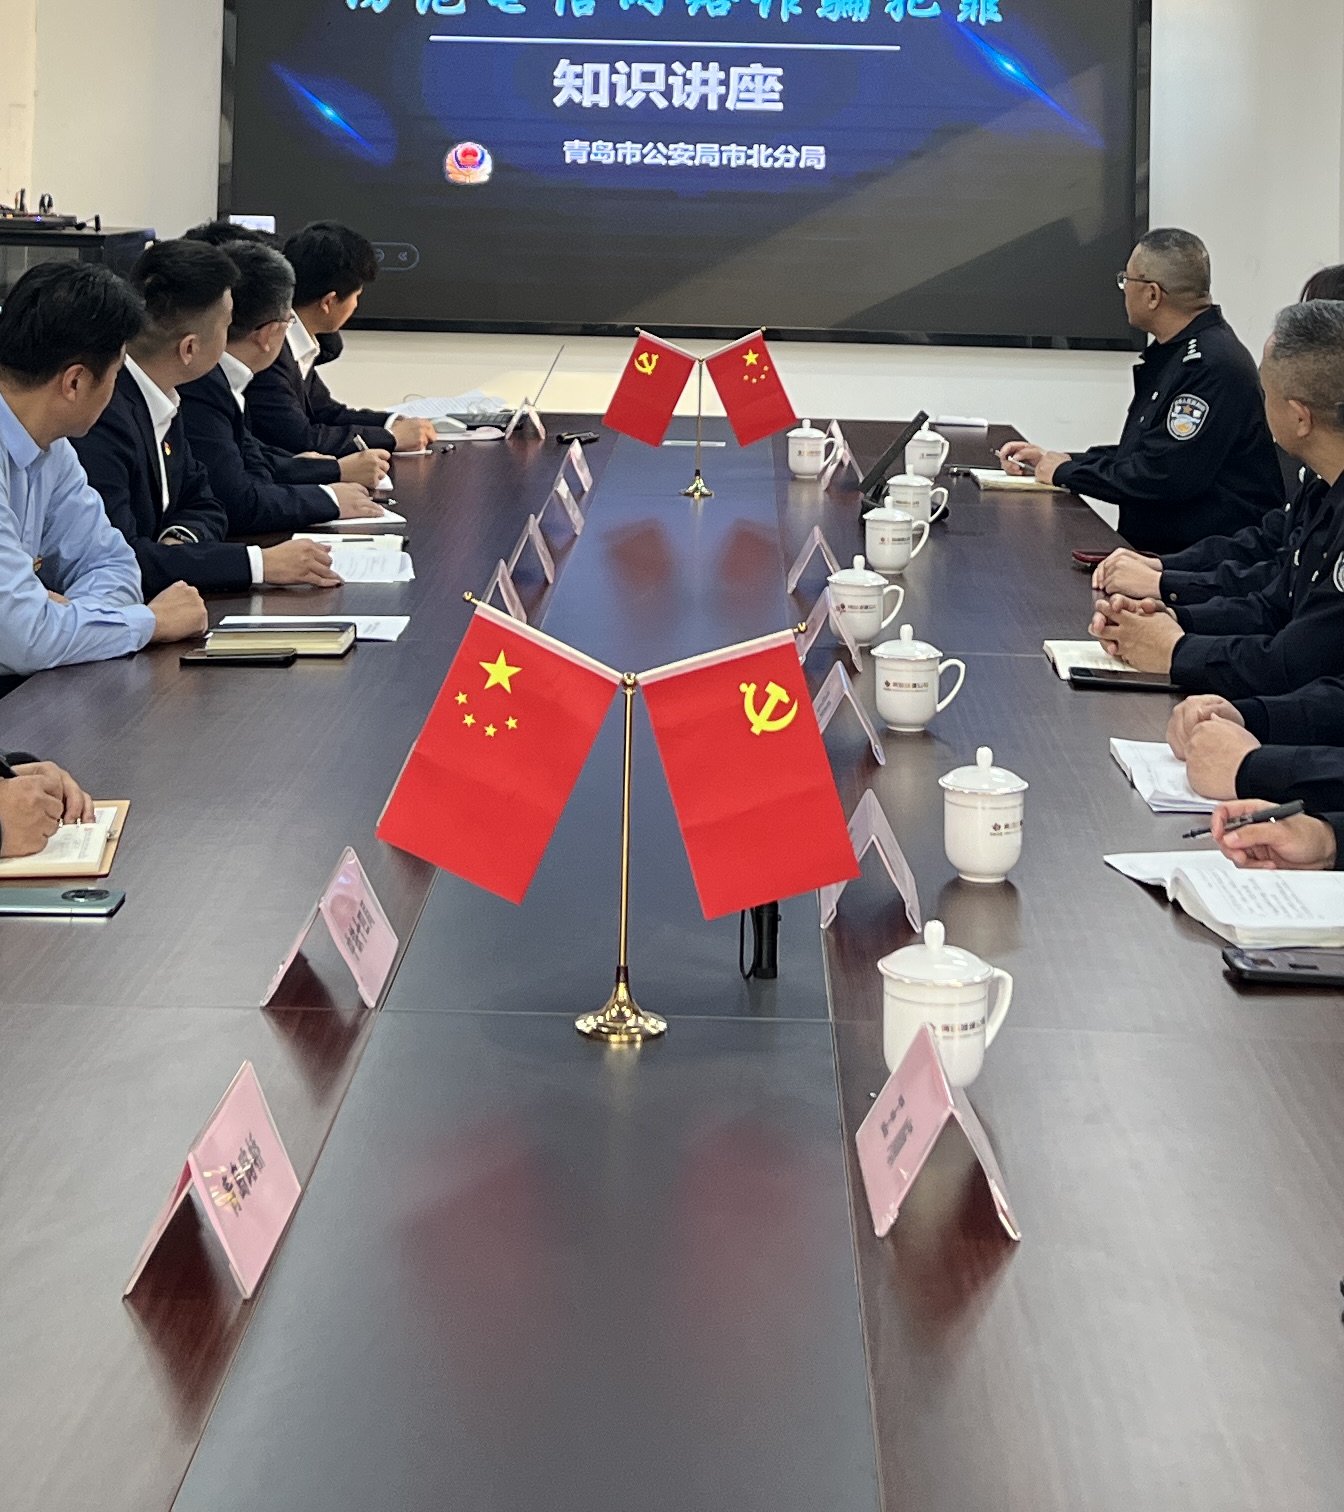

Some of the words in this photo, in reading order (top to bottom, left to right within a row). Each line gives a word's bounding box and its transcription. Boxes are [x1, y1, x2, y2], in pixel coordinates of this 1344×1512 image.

[551, 58, 785, 112] 知识讲座
[562, 139, 827, 170] 青岛市公安局市北分局
